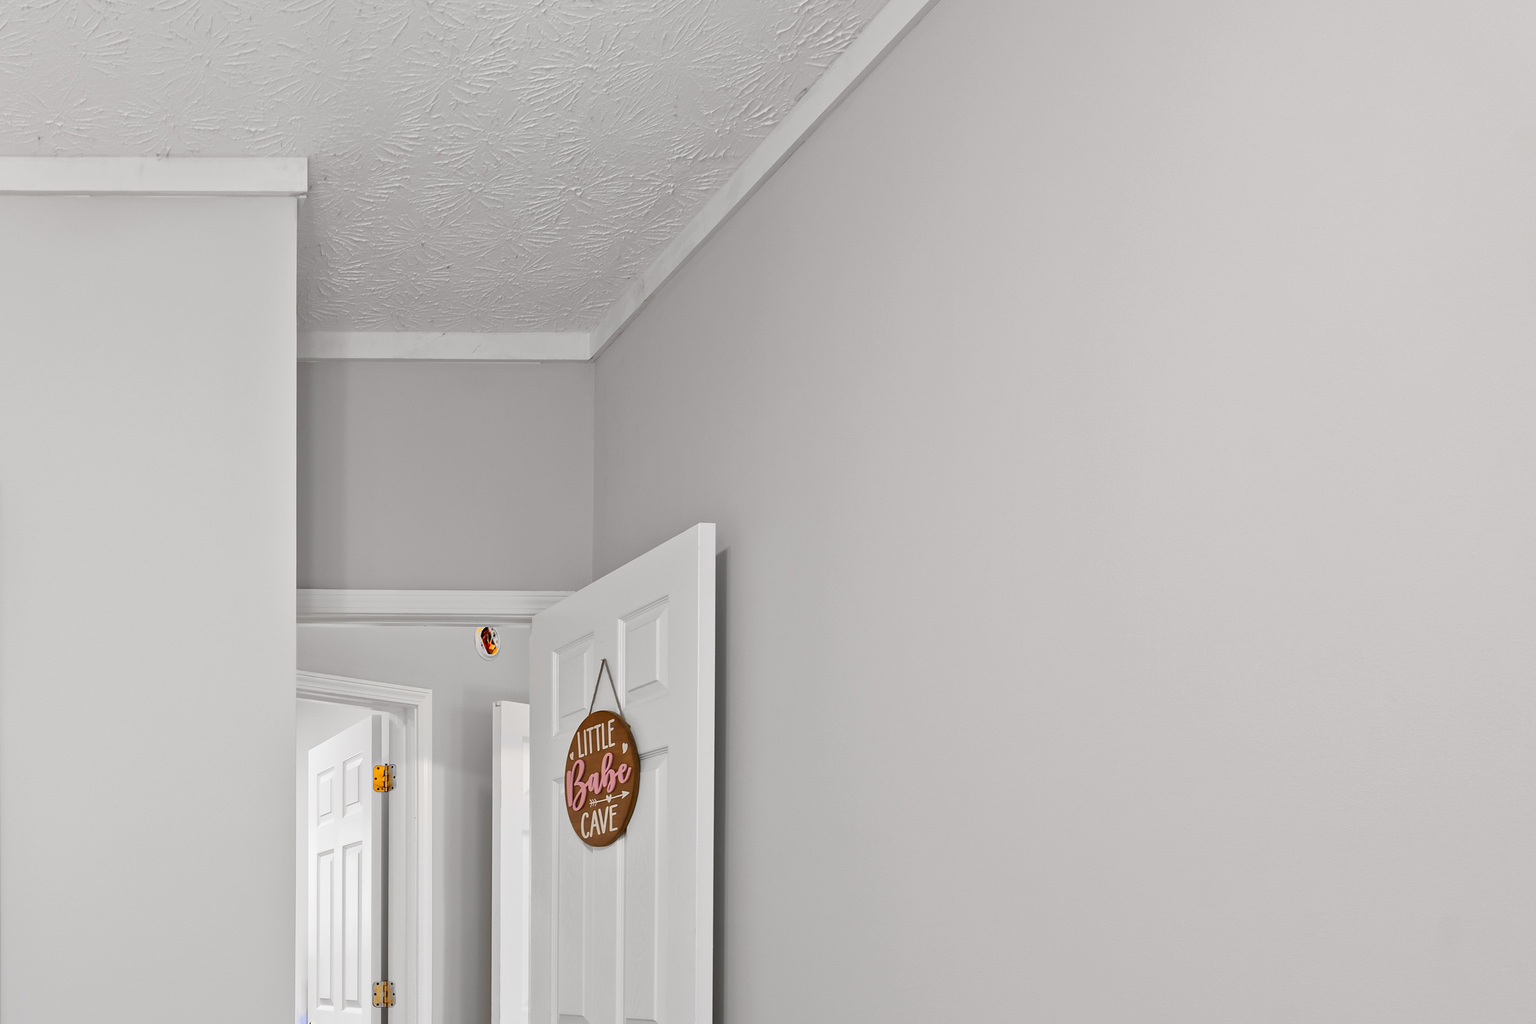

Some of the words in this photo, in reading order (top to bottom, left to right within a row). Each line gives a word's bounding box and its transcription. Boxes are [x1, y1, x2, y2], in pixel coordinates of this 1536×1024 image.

[577, 718, 616, 758] LITTLE
[566, 752, 632, 812] Babe
[581, 804, 618, 839] CAVE
